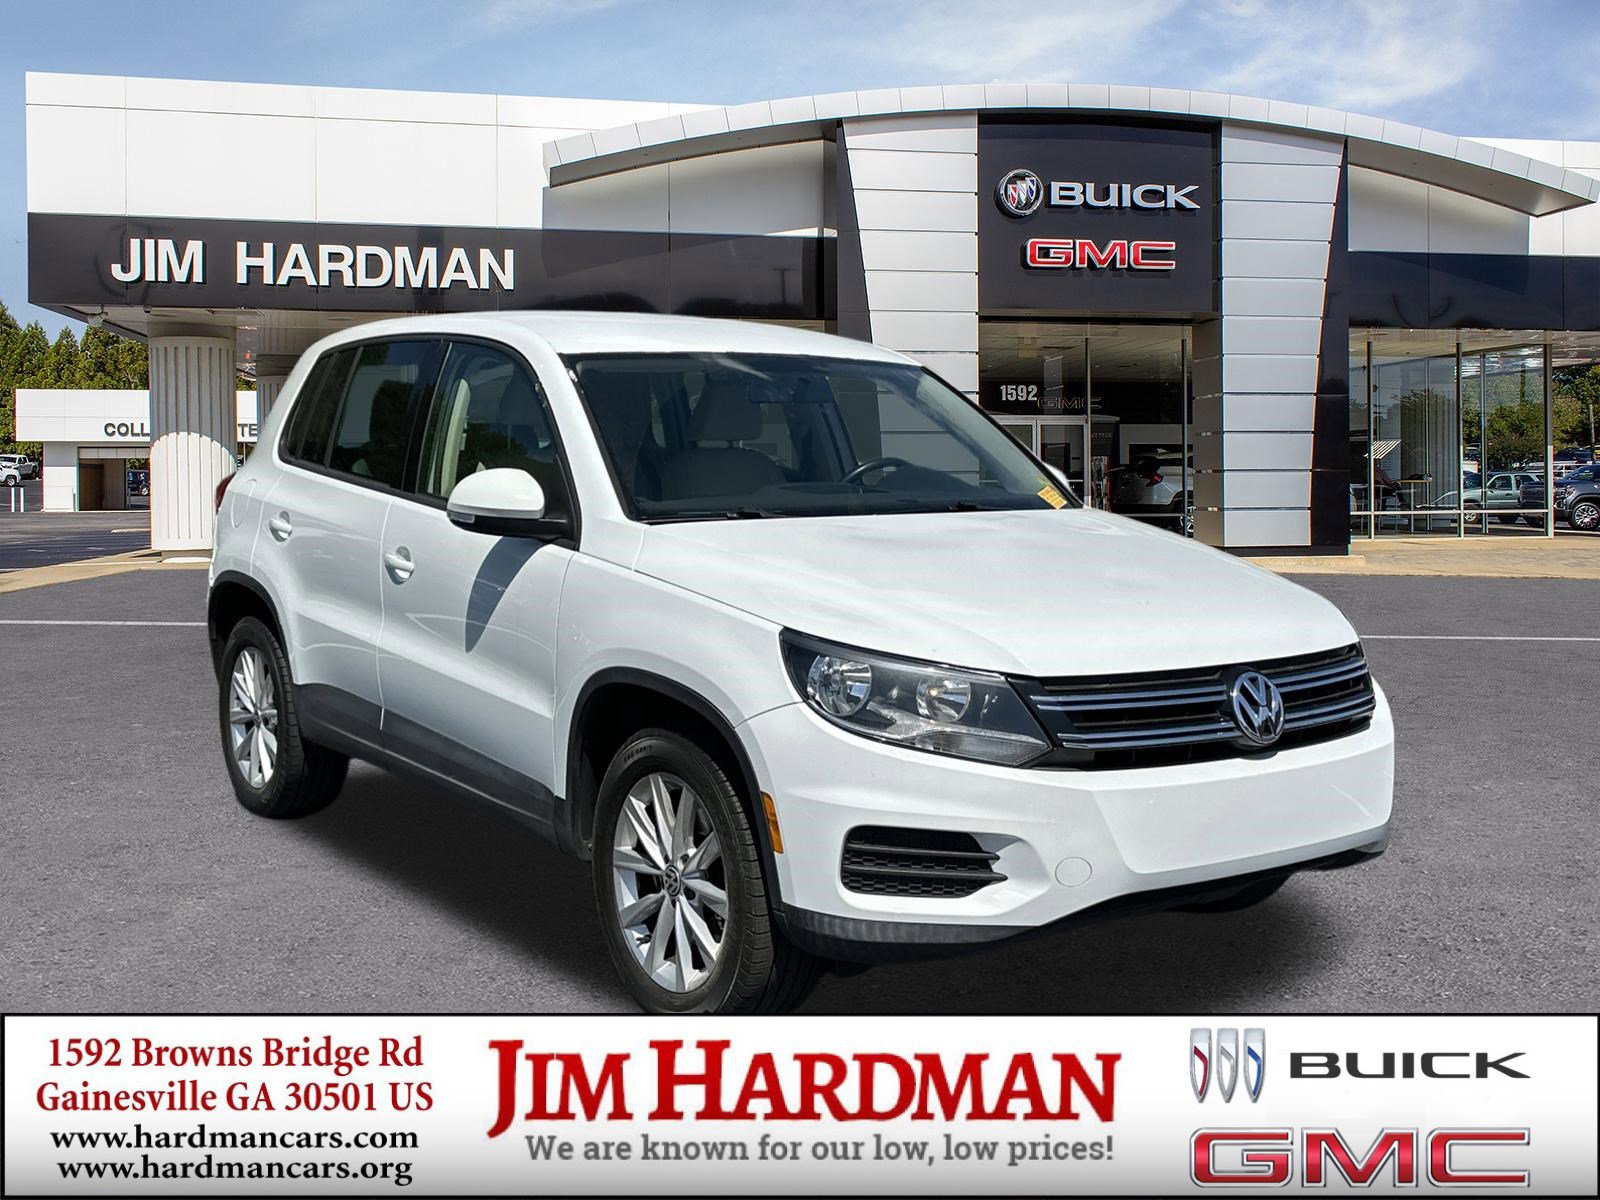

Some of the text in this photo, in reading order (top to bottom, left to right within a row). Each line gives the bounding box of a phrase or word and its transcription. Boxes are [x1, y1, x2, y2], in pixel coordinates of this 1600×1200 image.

[1050, 181, 1201, 211] BUICK
[111, 238, 515, 291] JIM HARDMAN
[1025, 238, 1177, 271] GMC
[1000, 384, 1038, 401] 1592
